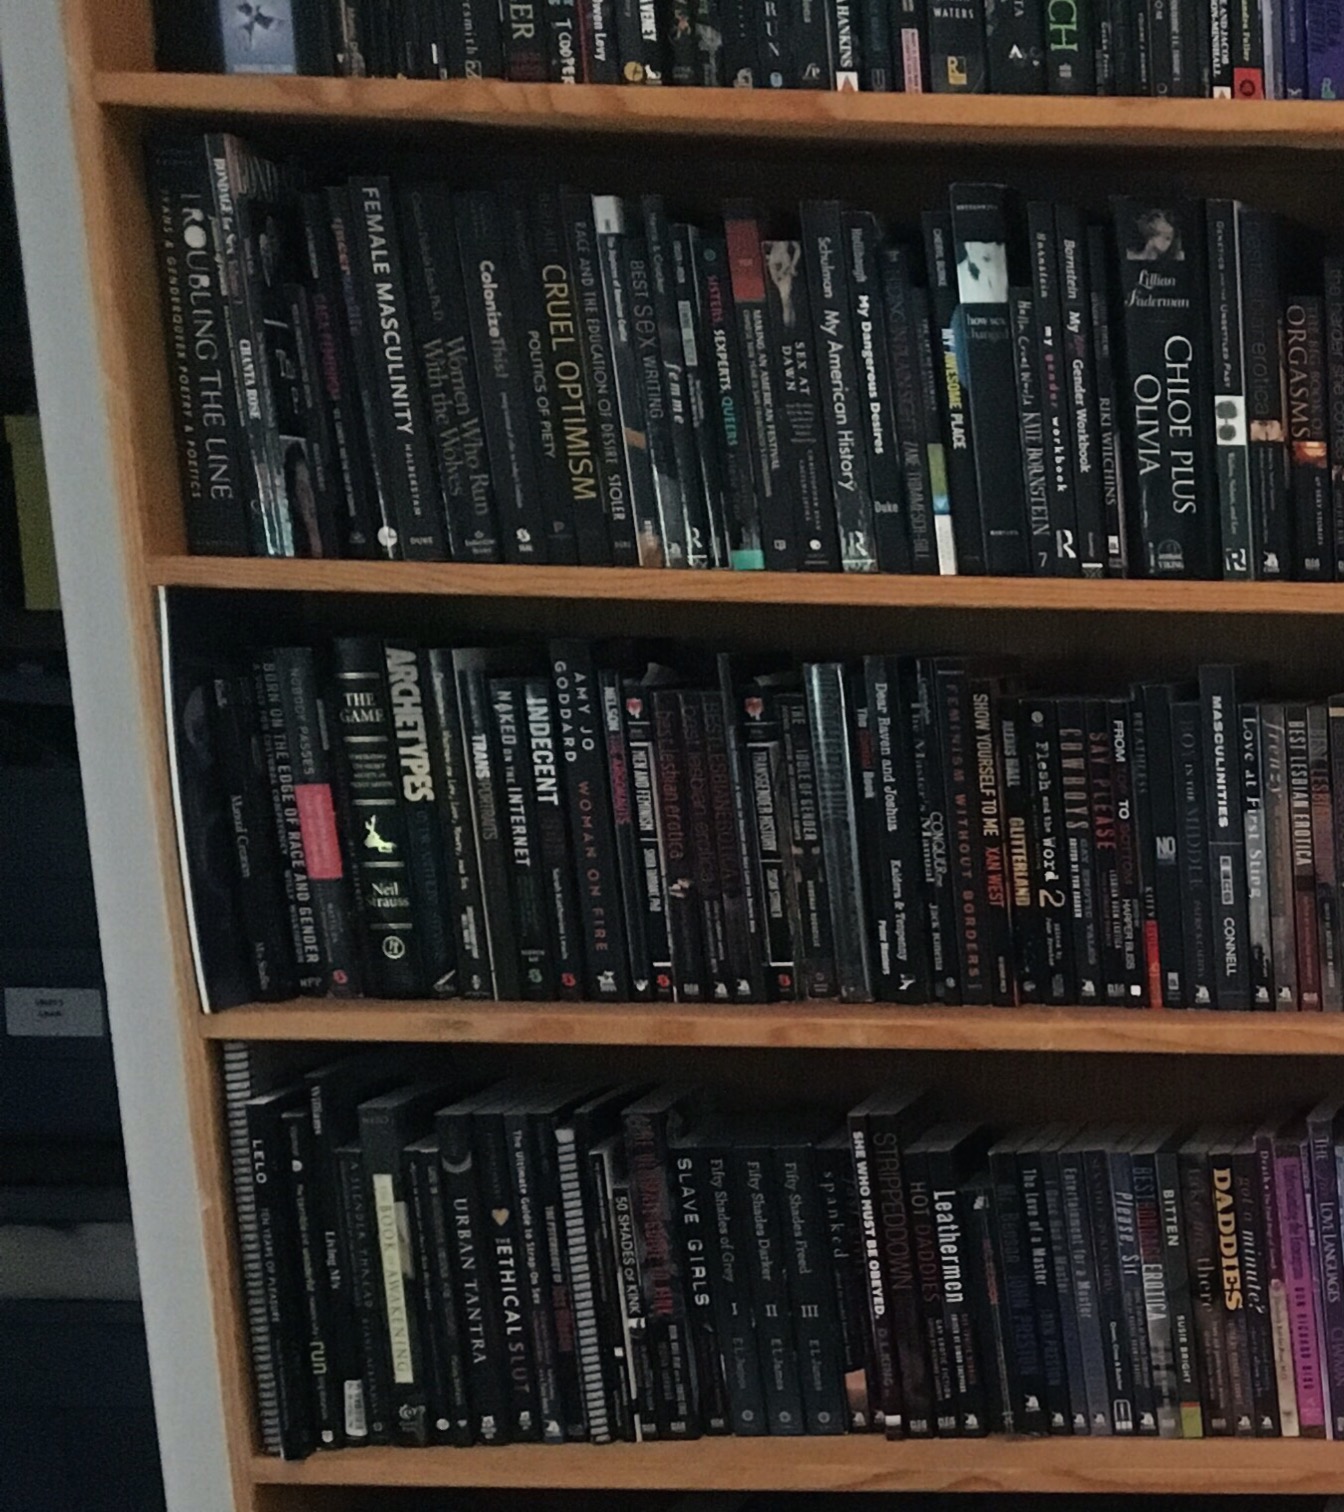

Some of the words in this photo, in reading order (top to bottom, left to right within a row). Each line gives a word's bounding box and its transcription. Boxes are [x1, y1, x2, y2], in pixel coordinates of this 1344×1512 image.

[362, 187, 389, 275] FEMALE
[819, 236, 836, 298] Schulman
[541, 264, 576, 351] CRUEL
[822, 310, 840, 336] My
[857, 295, 871, 317] My
[374, 282, 414, 435] MASCULINITY
[422, 337, 445, 388] With
[794, 342, 808, 369] SEX
[861, 321, 880, 398] Dangerous
[942, 328, 955, 347] MY
[199, 370, 225, 425] THE
[781, 346, 796, 392] DAWN
[799, 376, 810, 395] AT
[826, 340, 851, 425] American
[945, 351, 962, 409] AWESOME
[1164, 335, 1193, 438] CHLOE
[1287, 305, 1311, 439] ORGASMS
[431, 393, 448, 425] the
[445, 336, 472, 415] Women
[460, 417, 482, 469] Who
[472, 473, 491, 516] Run
[554, 360, 597, 500] OPTIMISM
[870, 402, 884, 454] Desires
[950, 413, 966, 449] PLACE
[1099, 397, 1113, 427] RIKI
[1133, 374, 1161, 475] OLIVIA
[204, 438, 232, 499] LINE
[439, 425, 465, 497] Wolves
[834, 431, 858, 492] History
[1102, 432, 1116, 505] WILCHINS
[1170, 450, 1196, 513] PLUS
[555, 661, 576, 762] GODDARD
[573, 672, 590, 714] AMY
[873, 683, 888, 713] Dear
[973, 694, 990, 731] SHOW
[385, 648, 434, 801] ARCHETYPES
[526, 697, 558, 805] INDECENT
[581, 726, 594, 751] JO
[878, 717, 892, 756] Raven
[495, 690, 516, 745] NAKED
[509, 787, 530, 868] INTERNET
[882, 759, 894, 782] and
[976, 733, 998, 797] YOURSELF
[579, 781, 594, 858] WOMAN
[882, 785, 897, 831] Joshua
[981, 799, 998, 815] TO
[983, 818, 999, 837] ME
[1212, 695, 1228, 828] MASCULINITIES
[1224, 917, 1237, 977] CONNELL
[586, 868, 601, 896] ON
[985, 847, 1001, 871] XAN
[1009, 817, 1030, 906] GLITTERLAND
[987, 874, 1004, 906] WEST
[594, 908, 607, 951] FIRE
[252, 1140, 266, 1184] LELO
[678, 1158, 700, 1224] SLAVE
[1162, 1189, 1178, 1246] BITTEN
[1213, 1168, 1244, 1311] DADDIES
[453, 1198, 475, 1270] URBAN
[464, 1279, 487, 1364] TANTRA
[688, 1239, 710, 1307] GIRLS
[496, 1244, 518, 1335] ETHICAL
[509, 1342, 529, 1394] SLUT
